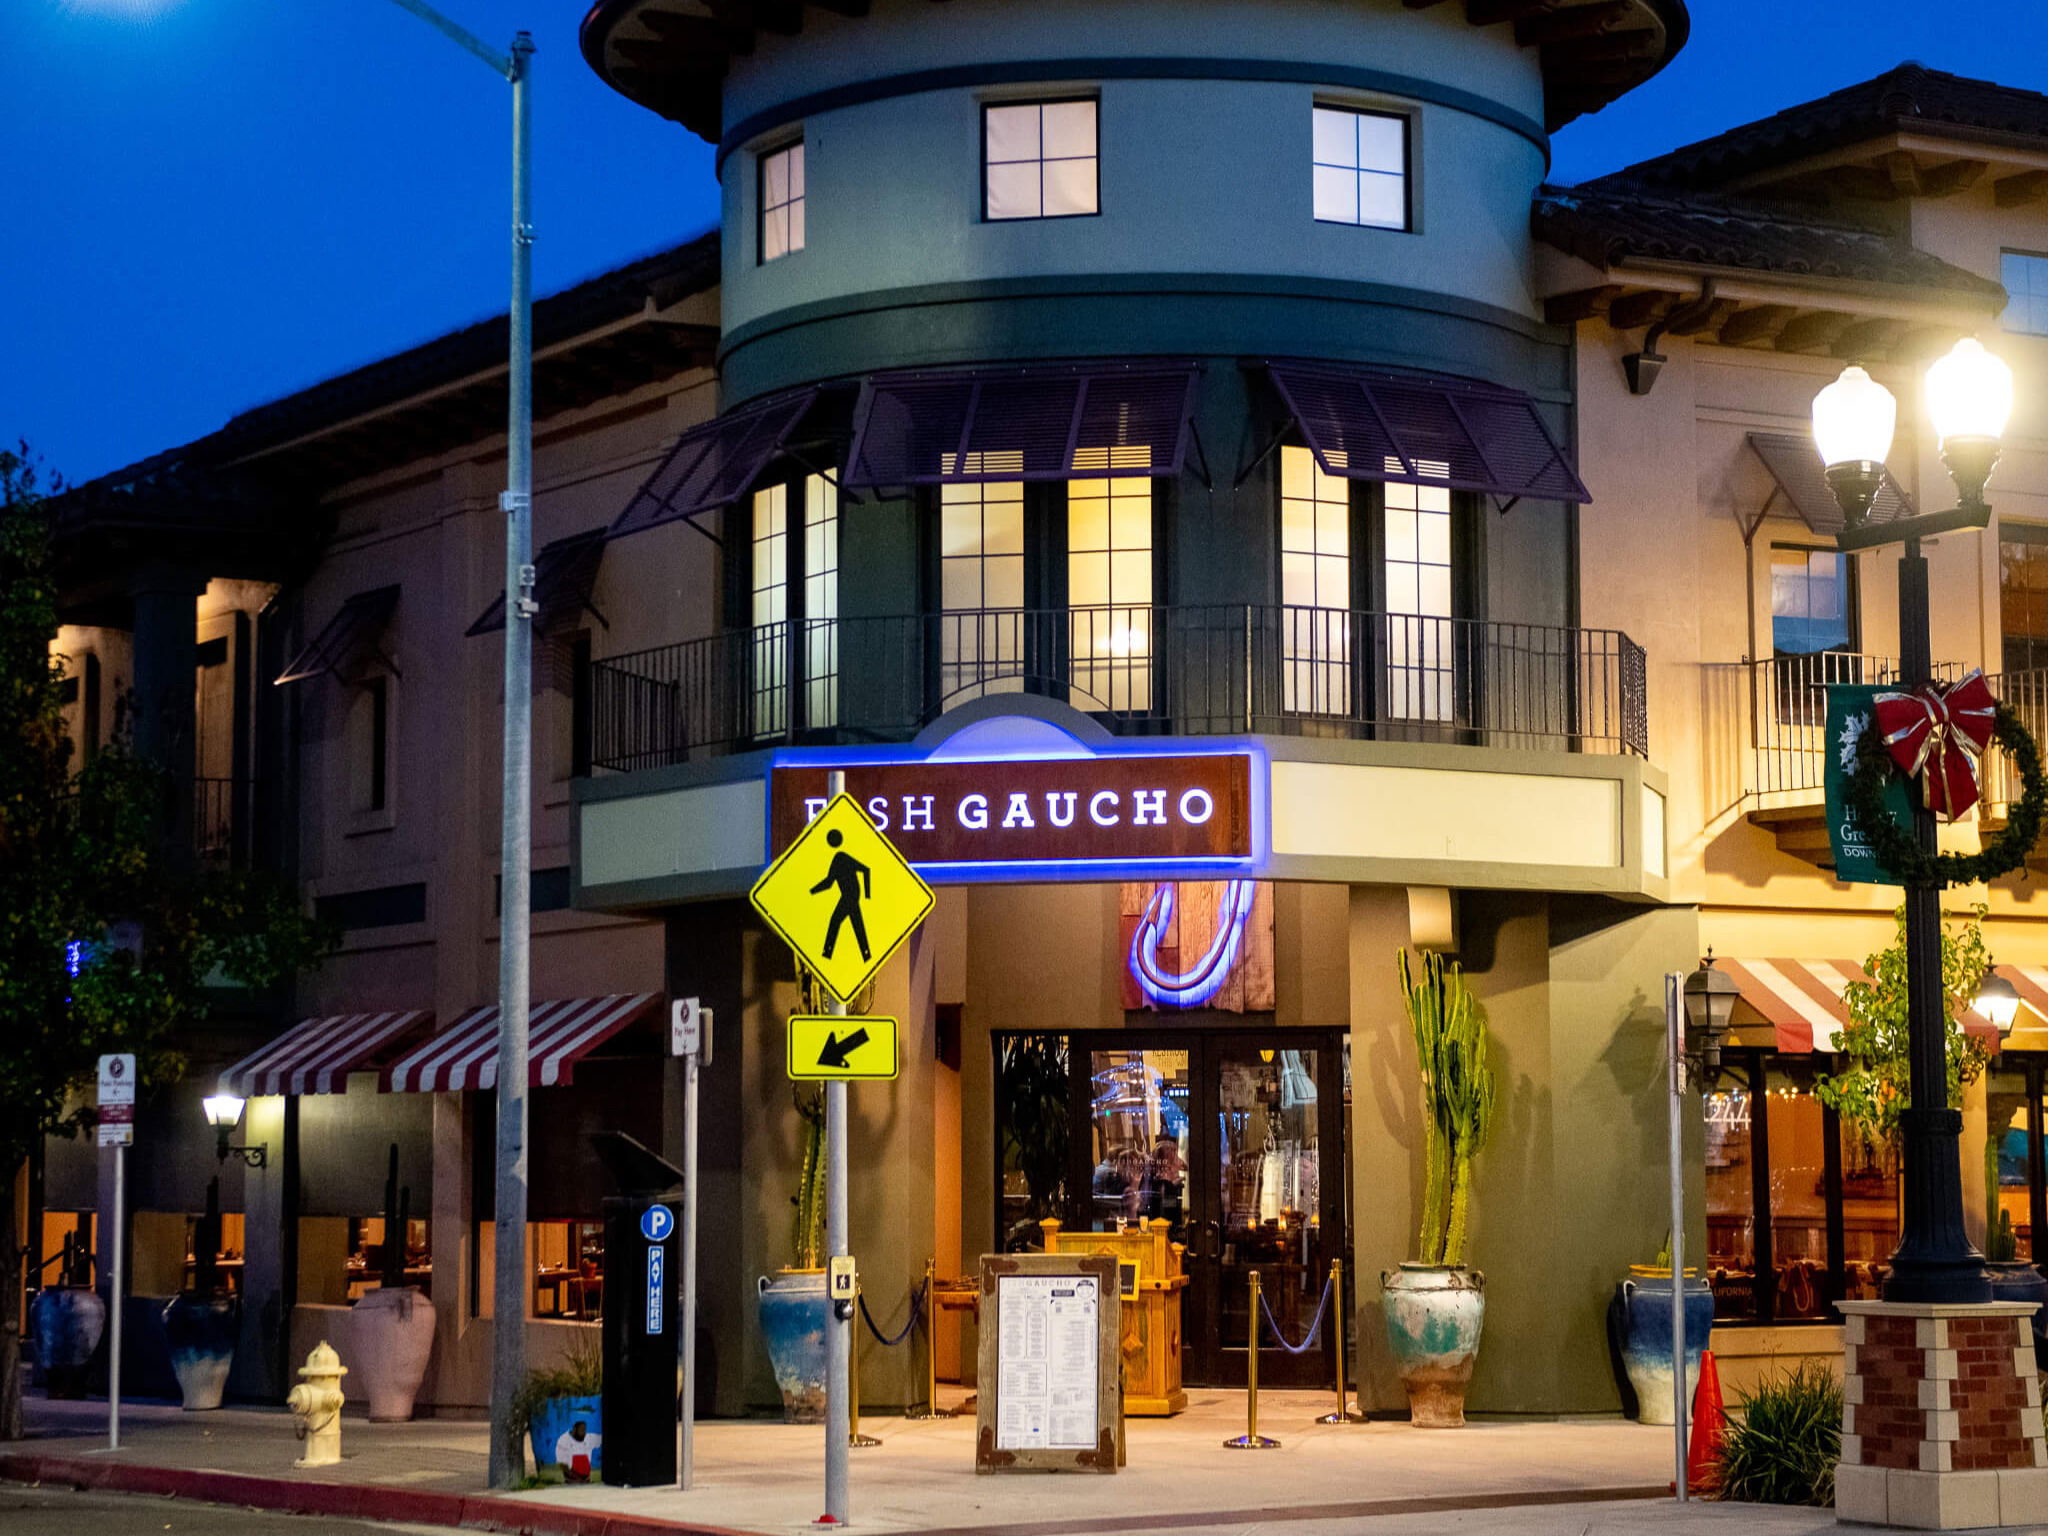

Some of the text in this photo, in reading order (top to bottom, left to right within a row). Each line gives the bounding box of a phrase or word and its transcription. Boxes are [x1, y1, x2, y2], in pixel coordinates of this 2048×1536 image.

[804, 788, 1214, 832] FSH GAUCHO
[651, 1211, 666, 1235] P
[650, 1250, 661, 1330] PAY HERE
